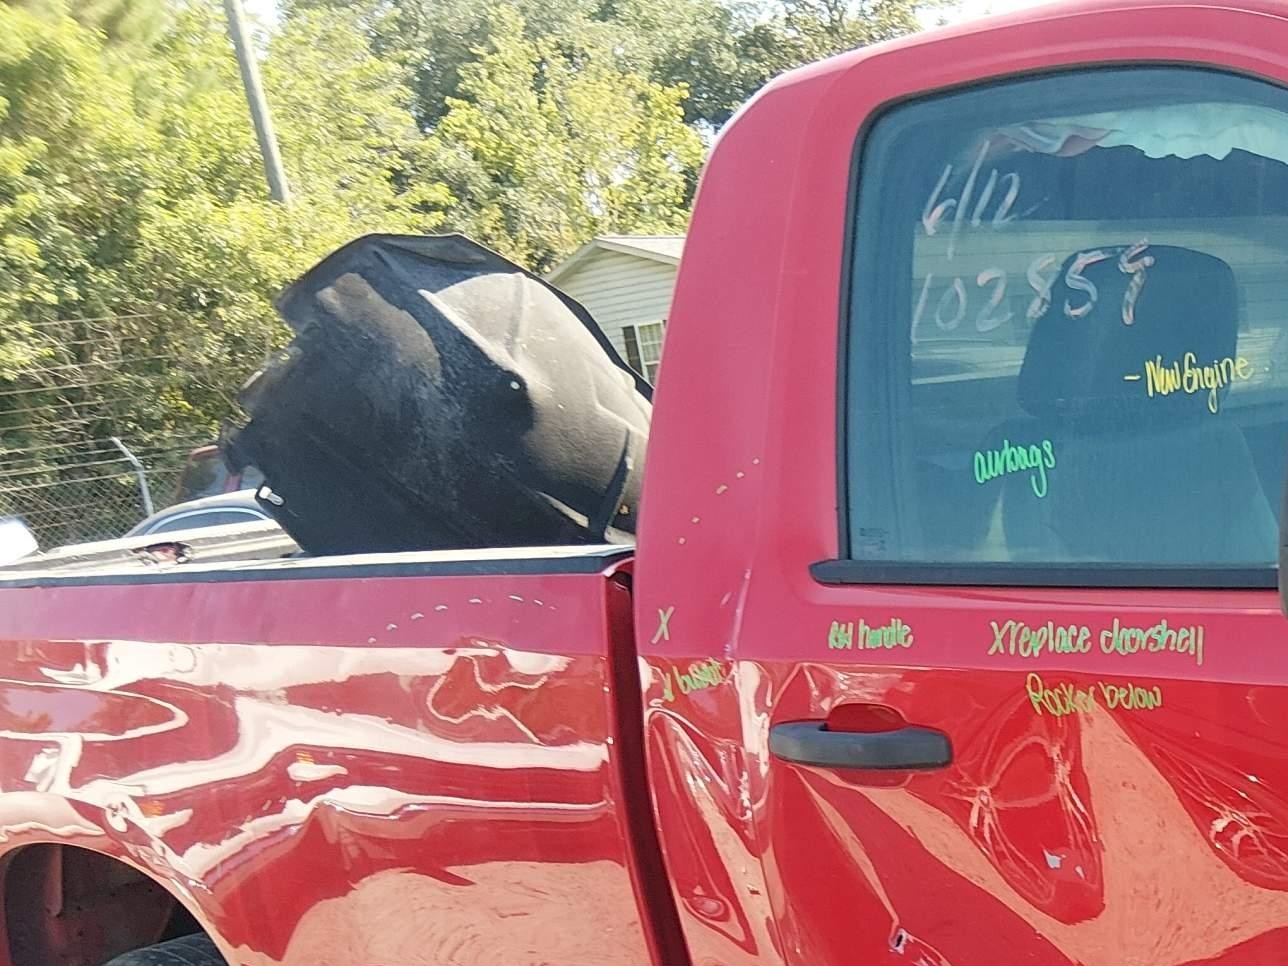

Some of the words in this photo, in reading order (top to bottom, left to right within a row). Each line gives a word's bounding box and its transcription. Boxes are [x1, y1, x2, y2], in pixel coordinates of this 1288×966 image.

[1144, 354, 1182, 398] New
[1183, 351, 1255, 414] Engine
[858, 617, 914, 650] handle
